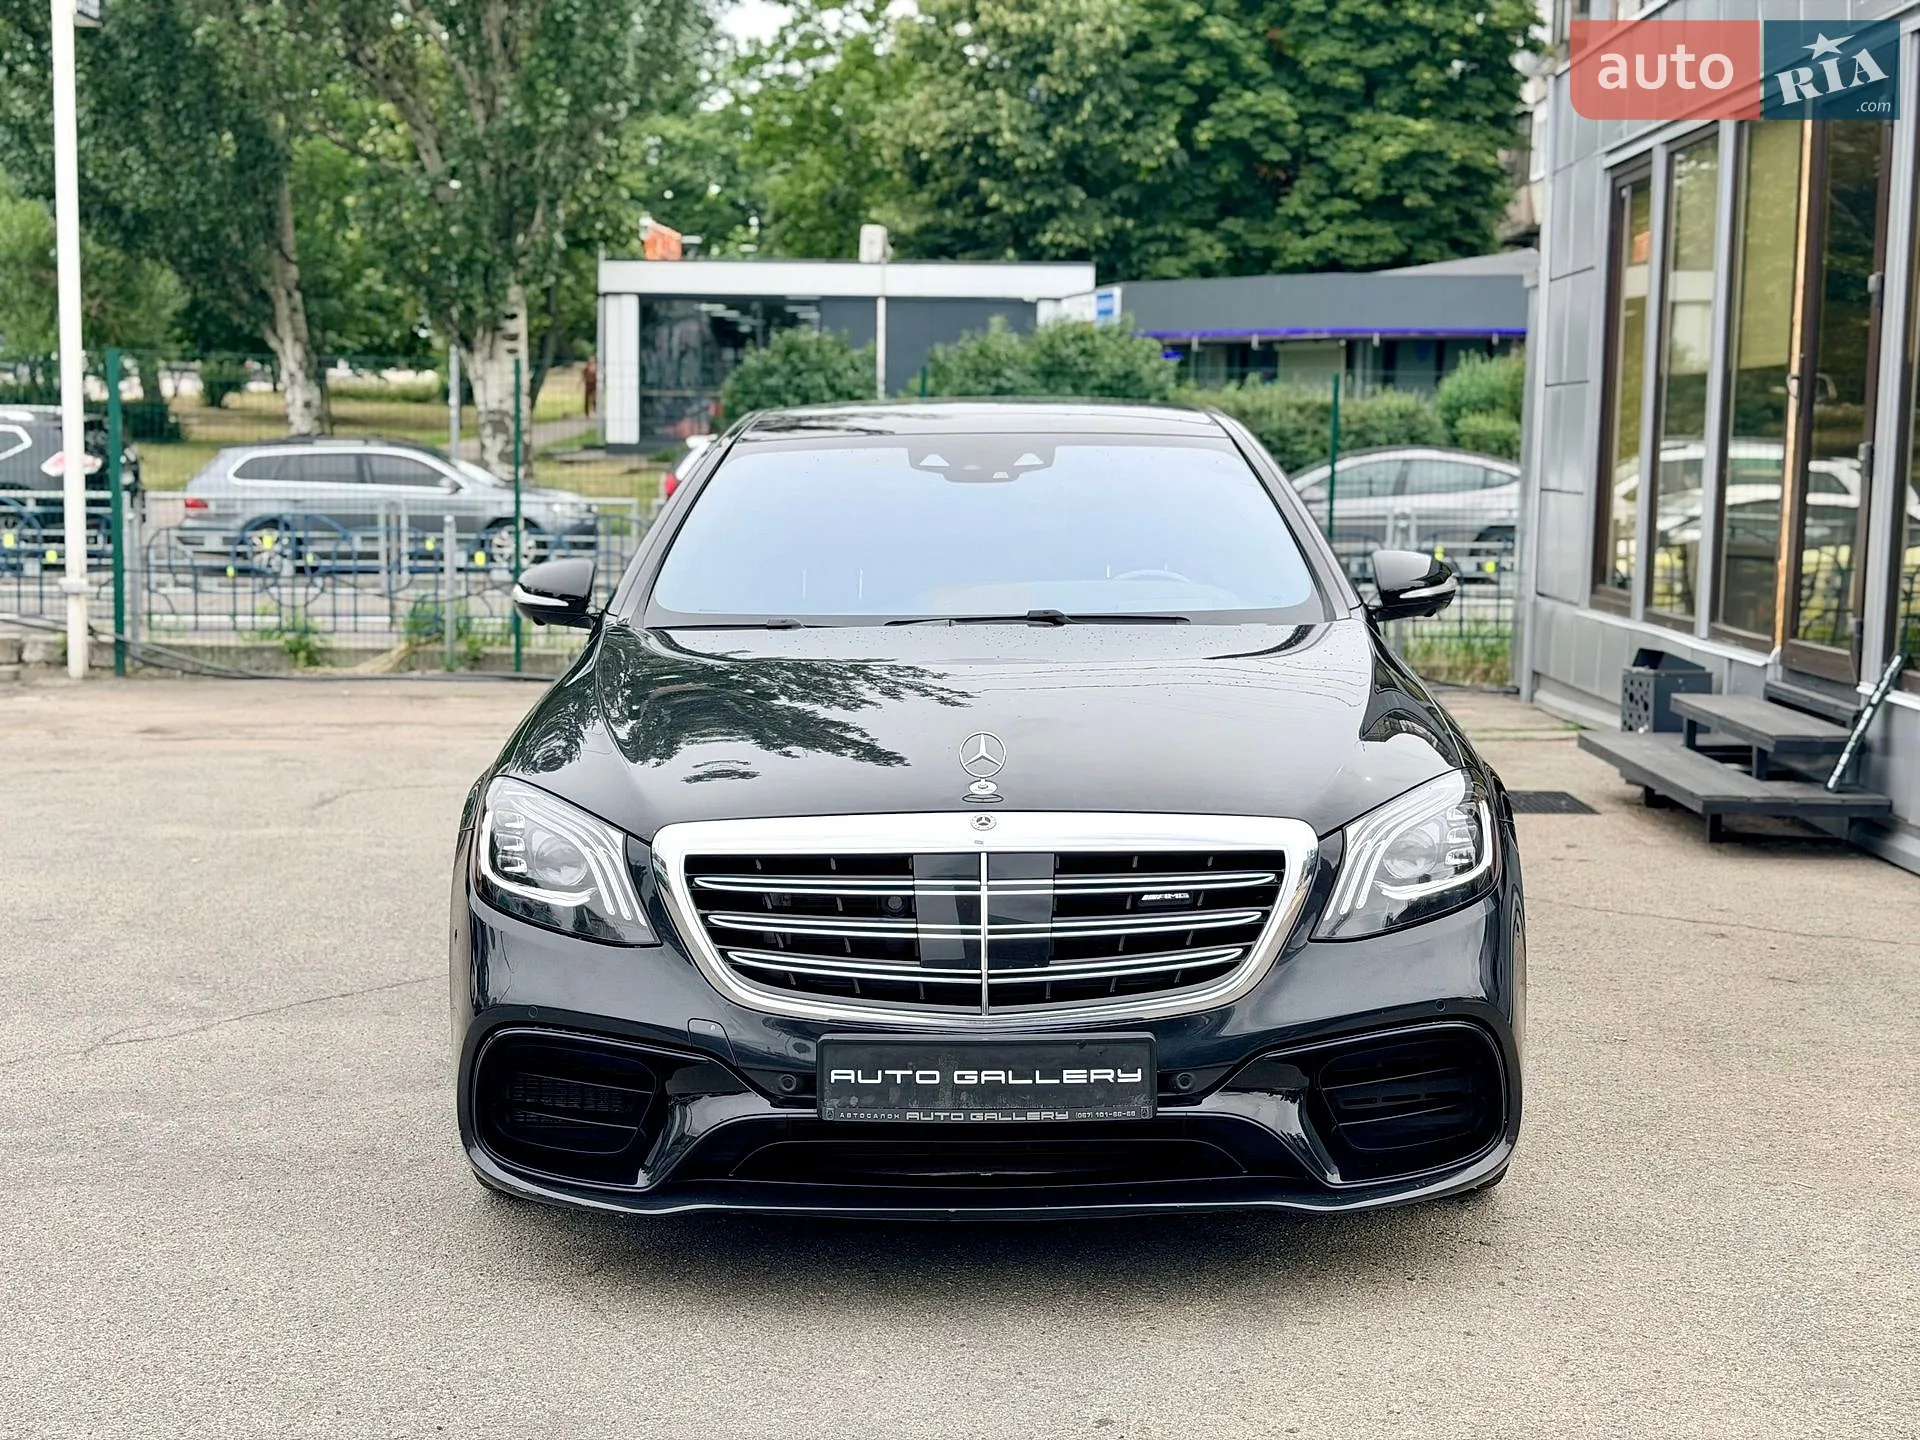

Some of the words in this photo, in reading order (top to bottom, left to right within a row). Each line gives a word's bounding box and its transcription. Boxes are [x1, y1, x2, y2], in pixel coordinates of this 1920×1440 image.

[830, 1069, 941, 1085] AUTO
[953, 1068, 1143, 1084] GALLERY
[906, 1111, 964, 1121] AUTO
[970, 1110, 1069, 1121] GALLERY
